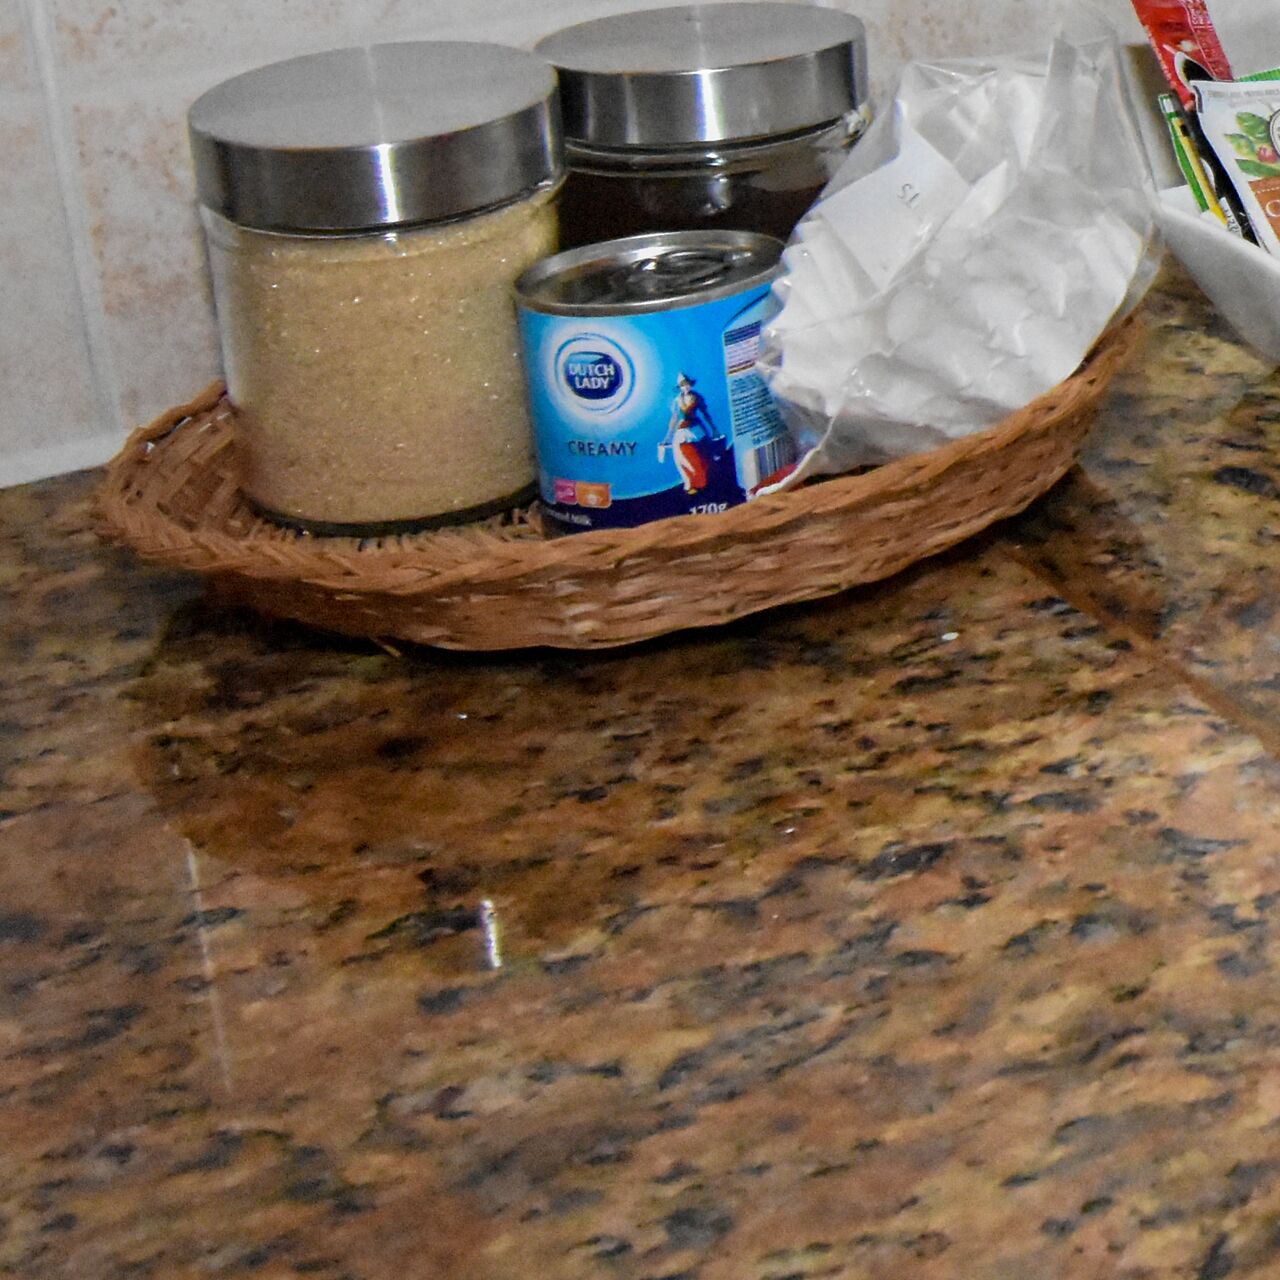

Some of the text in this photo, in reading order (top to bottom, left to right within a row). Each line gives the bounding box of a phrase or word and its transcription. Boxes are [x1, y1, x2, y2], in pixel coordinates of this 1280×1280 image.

[568, 363, 615, 376] DUTCH
[574, 377, 610, 389] LADY
[567, 440, 637, 457] CREAMY
